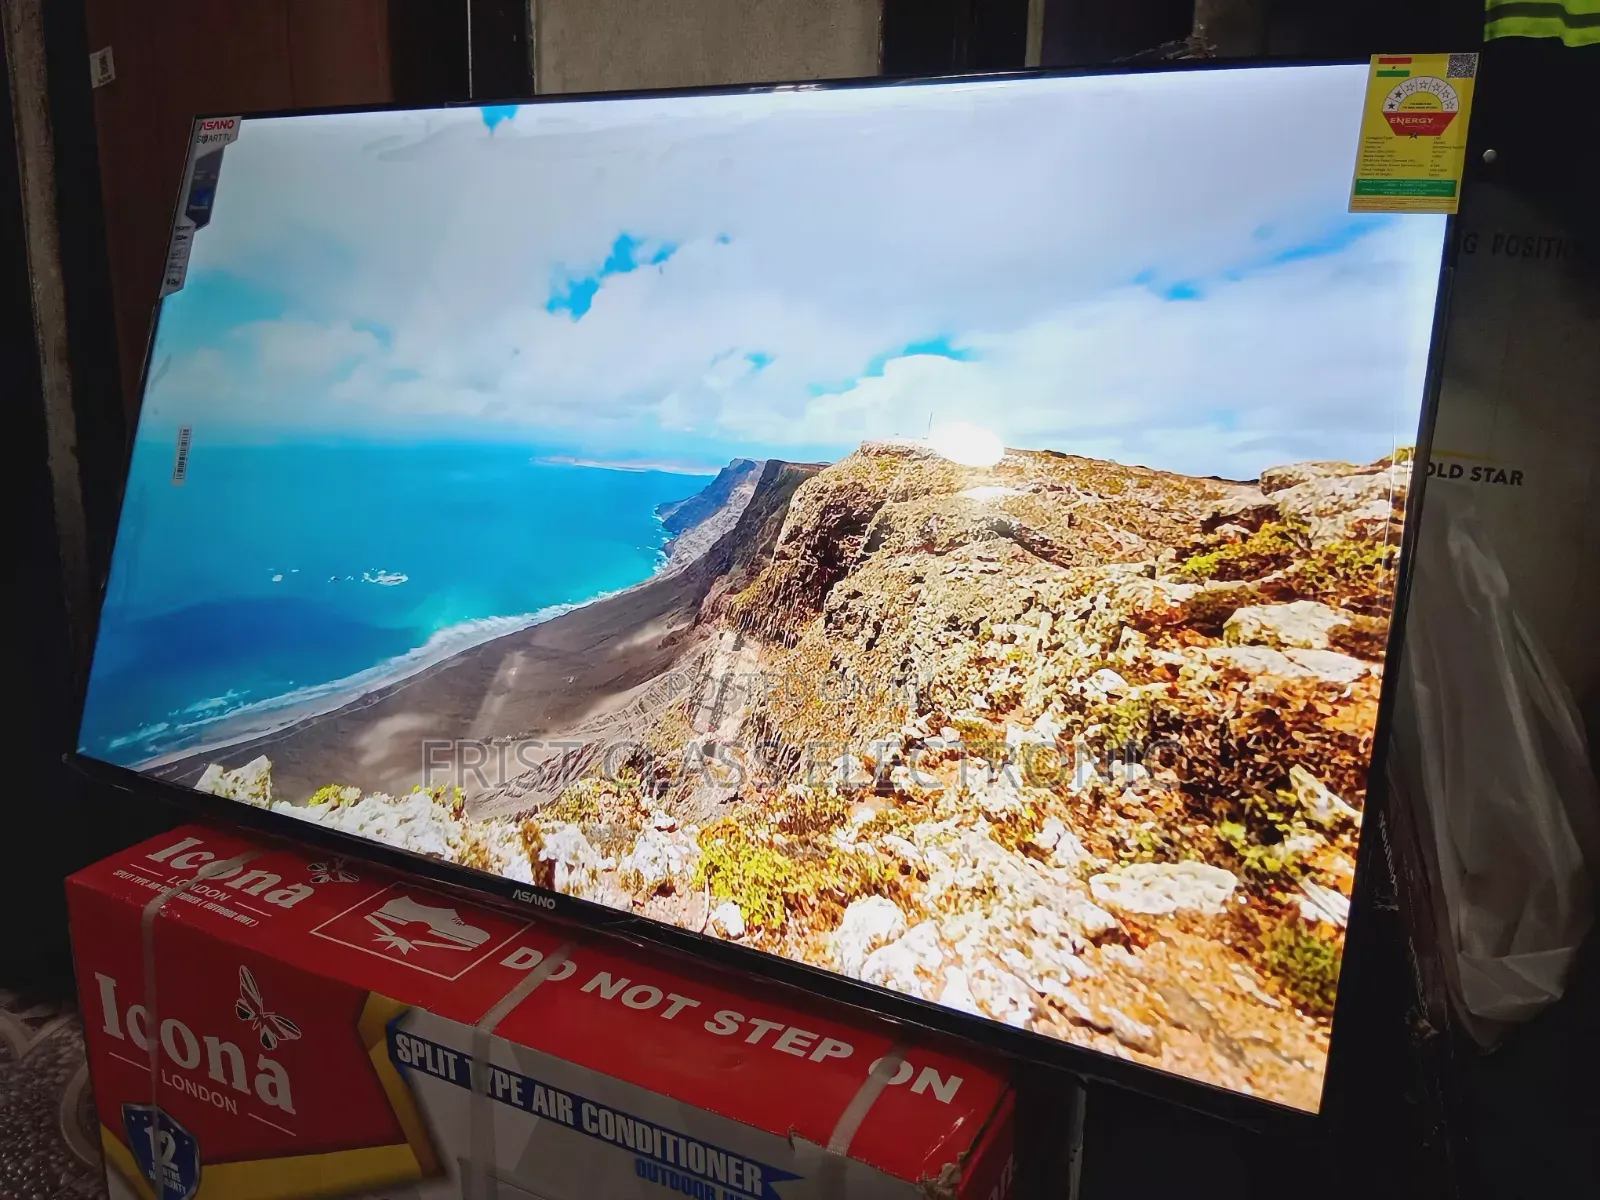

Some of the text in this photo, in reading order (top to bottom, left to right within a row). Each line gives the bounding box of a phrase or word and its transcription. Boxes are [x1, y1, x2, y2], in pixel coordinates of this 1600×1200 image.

[199, 119, 235, 131] ASANO
[223, 133, 232, 142] TV
[1390, 116, 1434, 125] ENERGY
[1491, 232, 1572, 260] POSITI
[1469, 466, 1524, 486] STAR
[113, 869, 133, 881] SPLIT
[130, 874, 149, 886] TYPE
[203, 902, 238, 919] OUTDOOR
[145, 836, 315, 909] Icona
[166, 875, 232, 902] LONDON
[512, 888, 556, 910] ASANO
[94, 971, 297, 1116] Icona
[499, 946, 964, 1105] DO NOT STEP ON
[160, 1068, 238, 1116] LONDON
[395, 1033, 458, 1081] SPLIT
[532, 1084, 575, 1126] AIR
[581, 1102, 763, 1197] CONDITIONER
[143, 1125, 179, 1171] 12
[635, 1156, 717, 1200] OUTDOOR
